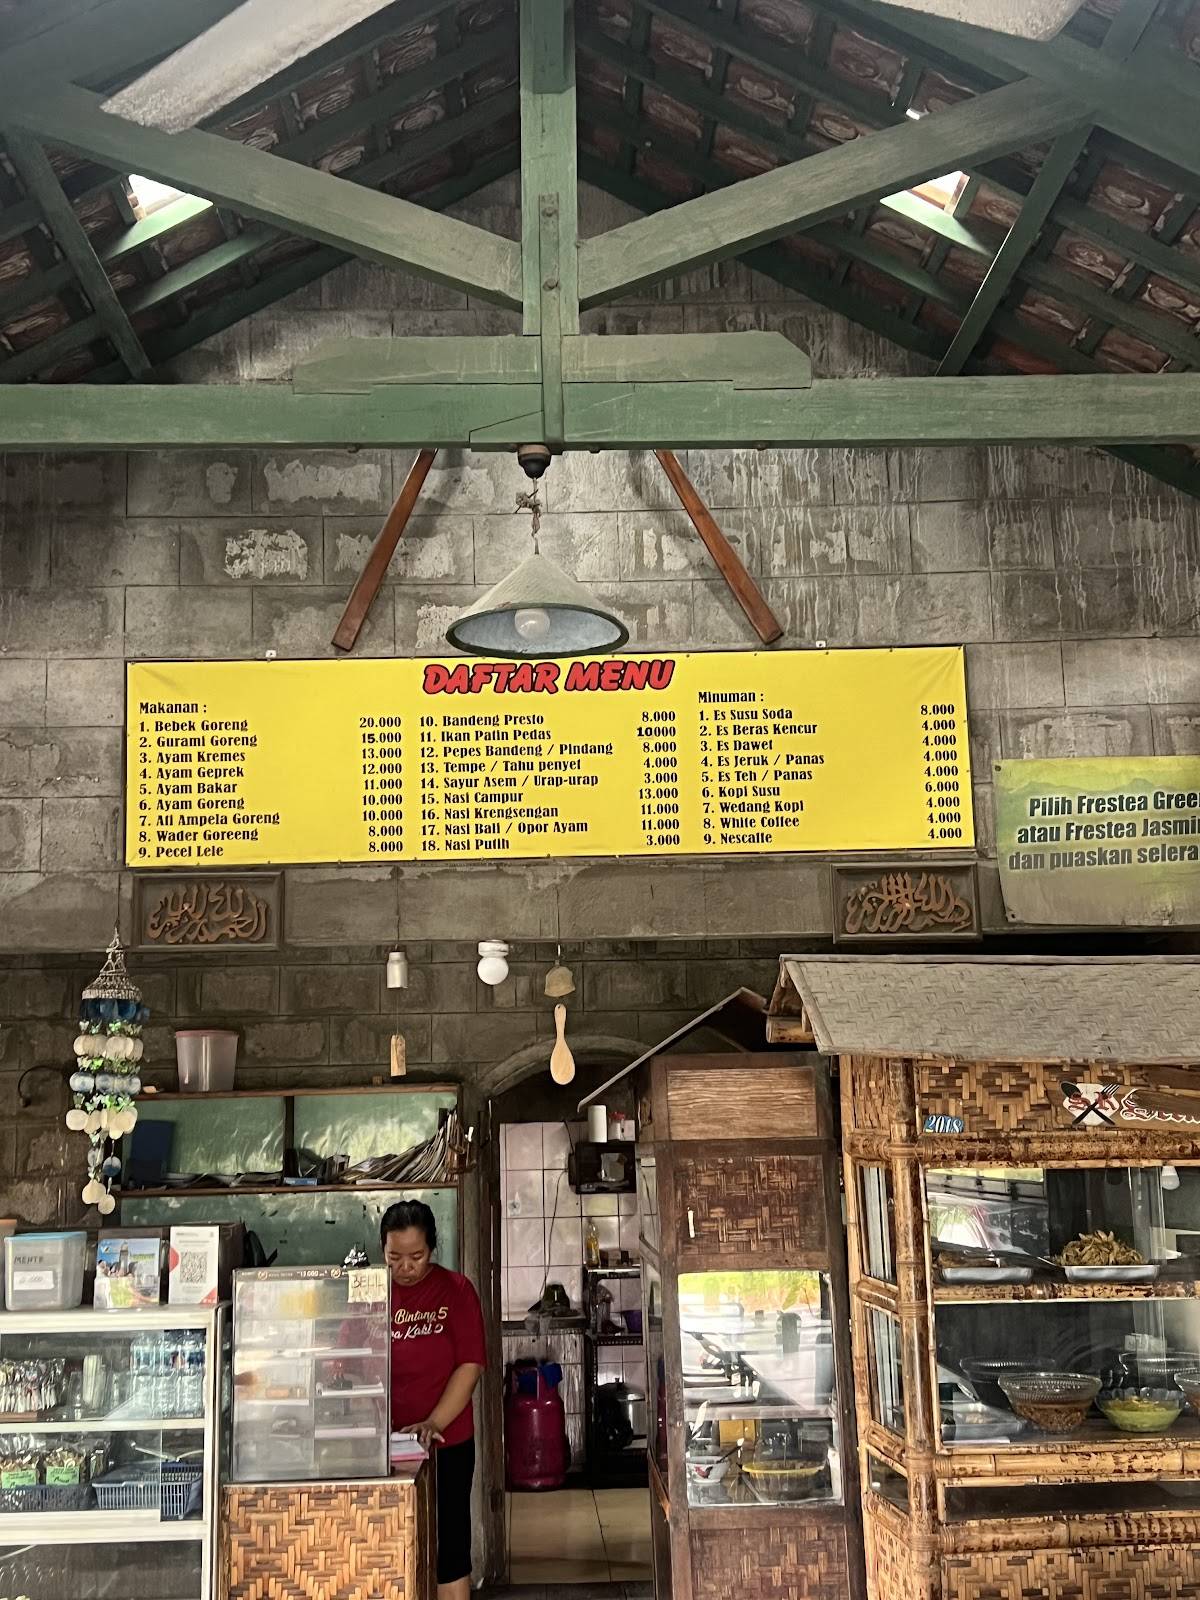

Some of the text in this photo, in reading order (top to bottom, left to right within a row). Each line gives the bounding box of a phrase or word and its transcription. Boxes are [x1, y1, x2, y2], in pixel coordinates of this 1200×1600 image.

[423, 660, 675, 695] DAFTAR MENU
[698, 691, 756, 704] Minuman
[139, 702, 199, 714] Makanan
[699, 704, 954, 721] 1. Es Susu Soda 8.000
[140, 717, 401, 732] 1. Bebek Goreng 20.000
[420, 711, 675, 727] 10. Bandeng Presto 8.000
[420, 731, 436, 743] 11.
[441, 731, 471, 742] Ikan
[474, 729, 509, 741] Patin
[513, 729, 551, 741] Pedas
[699, 720, 955, 737] 2. Es Beras Kencur 4.000
[139, 733, 401, 748] 2. Gurami Goreng 15.000
[700, 735, 956, 752] 3. Es Dawet 4.000
[139, 748, 402, 765] 3. Ayam Kremes 13.000
[420, 746, 439, 758] 12.
[443, 746, 481, 759] Pepes
[485, 744, 543, 757] Bandeng
[559, 742, 613, 755] Pindang
[643, 742, 676, 752] 8.000
[700, 755, 713, 767] 4.
[717, 755, 730, 767] Es
[734, 754, 769, 768] Jeruk
[785, 754, 825, 765] Panas
[924, 750, 957, 761] 4.000
[139, 763, 402, 780] 4. Ayam Geprek 12.000
[421, 762, 439, 774] 13.
[443, 761, 486, 774] Tempe
[502, 760, 534, 772] Tahu
[538, 758, 581, 772] penyet
[644, 757, 677, 768] 4.000
[421, 777, 439, 789] 14.
[443, 777, 480, 790] Sayur
[483, 776, 517, 788] Asem
[534, 775, 599, 788] Urap-urap
[644, 773, 677, 783] 3.000
[701, 771, 713, 783] 5.
[718, 771, 731, 782] Es
[734, 770, 757, 782] Teh
[774, 769, 813, 781] Panas
[925, 766, 958, 777] 4.000
[139, 779, 402, 796] 5. Ayam Bakar 11.000
[701, 781, 959, 799] 6. Kopi Susu 6.000
[139, 794, 402, 812] 6. Ayam Goreng 10.000
[421, 788, 678, 805] 15. Nasi Campur 13.000
[1029, 791, 1200, 817] Pilih Frestea Gree
[422, 804, 679, 820] 16. Nasi Krengsengan 11.000
[702, 797, 960, 814] 7. Wedang Kopi 4.000
[139, 810, 402, 827] 7. Ati Ampela Goreng 10.000
[703, 812, 961, 829] 8. White Coffee 4.000
[138, 826, 403, 843] 8. Wader Goreeng 8.000
[422, 824, 440, 836] 17.
[445, 823, 470, 836] Nasi
[474, 822, 501, 835] Bali
[518, 822, 549, 835] Opor
[553, 821, 588, 834] Ayam
[642, 819, 679, 830] 11.000
[1017, 816, 1200, 844] atau Frestea Jasmi
[422, 835, 680, 852] 18. Nasi Putih 3.000
[703, 833, 716, 845] 9.
[928, 828, 962, 839] 4.000
[138, 841, 403, 858] 9. Pecel Lele 8.000
[1009, 844, 1199, 870] dan puaskan selera
[925, 1115, 962, 1133] 2018
[394, 1308, 437, 1325] Bintang
[437, 1306, 449, 1320] 5
